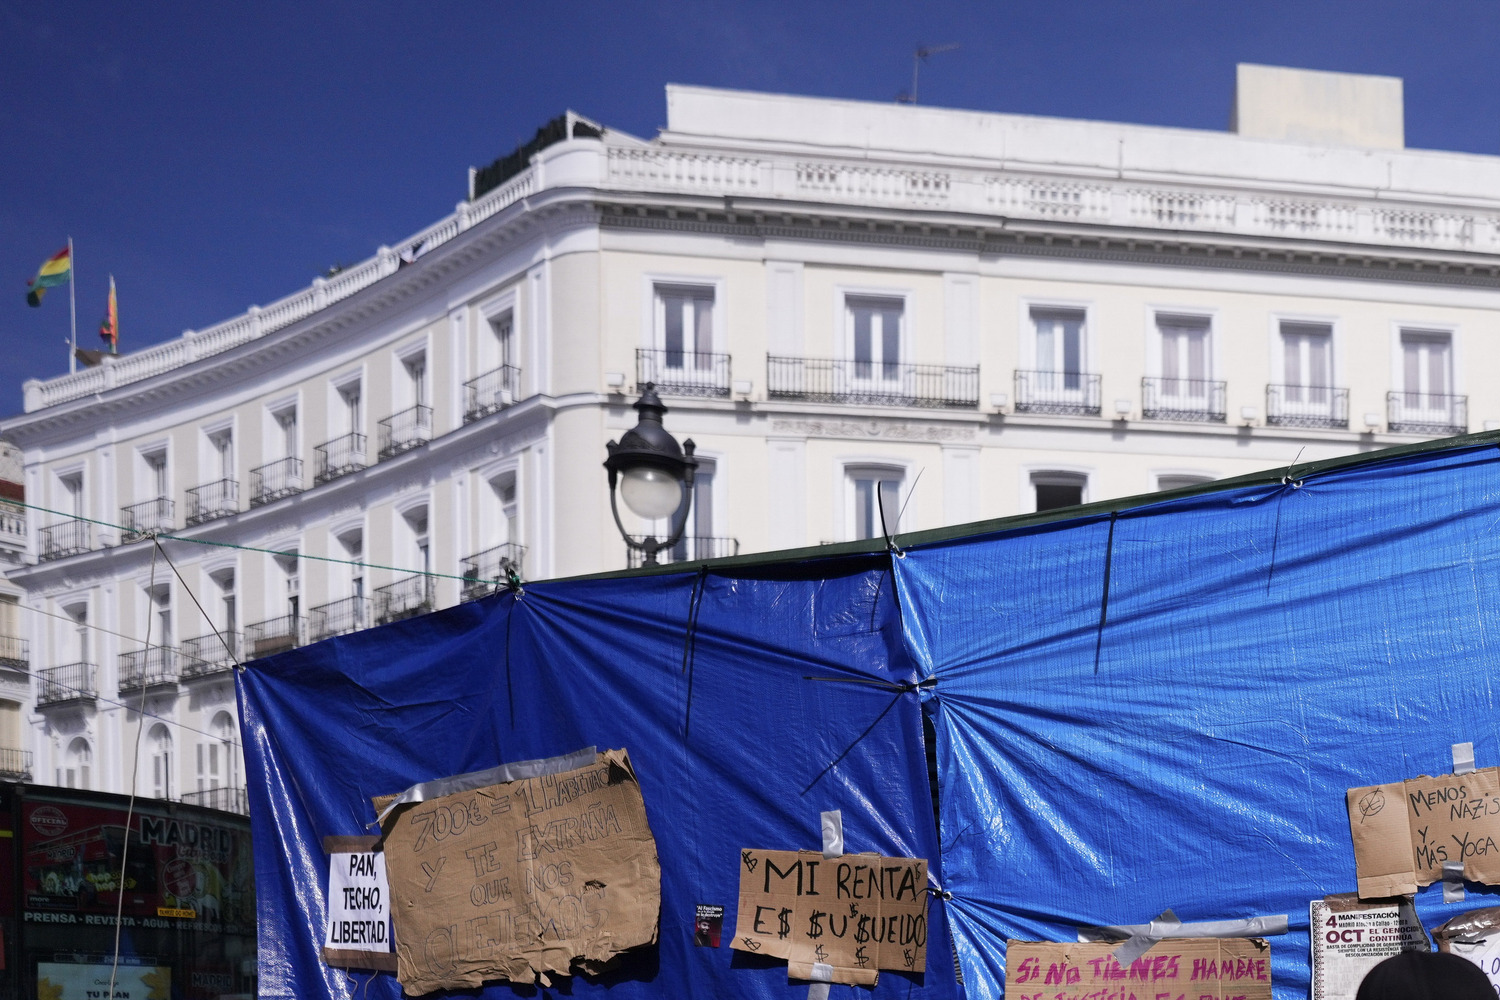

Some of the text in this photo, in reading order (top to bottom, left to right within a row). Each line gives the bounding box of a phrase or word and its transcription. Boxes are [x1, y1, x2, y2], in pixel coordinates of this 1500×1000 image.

[1409, 785, 1467, 816] MENOS
[139, 814, 234, 853] MADRID
[1417, 826, 1429, 843] Y
[1416, 832, 1499, 871] MÁS YOGA
[349, 853, 378, 880] PAN,
[763, 857, 917, 901] MI RENTA
[342, 887, 383, 913] TECHO,
[24, 911, 170, 930] PRENSA REVISTA AGUA
[331, 921, 388, 944] LIBERTAD.
[1325, 915, 1338, 929] 4
[1325, 929, 1365, 944] OCT
[1190, 957, 1268, 981] HAMBRE
[86, 990, 130, 1000] TU PLAN
